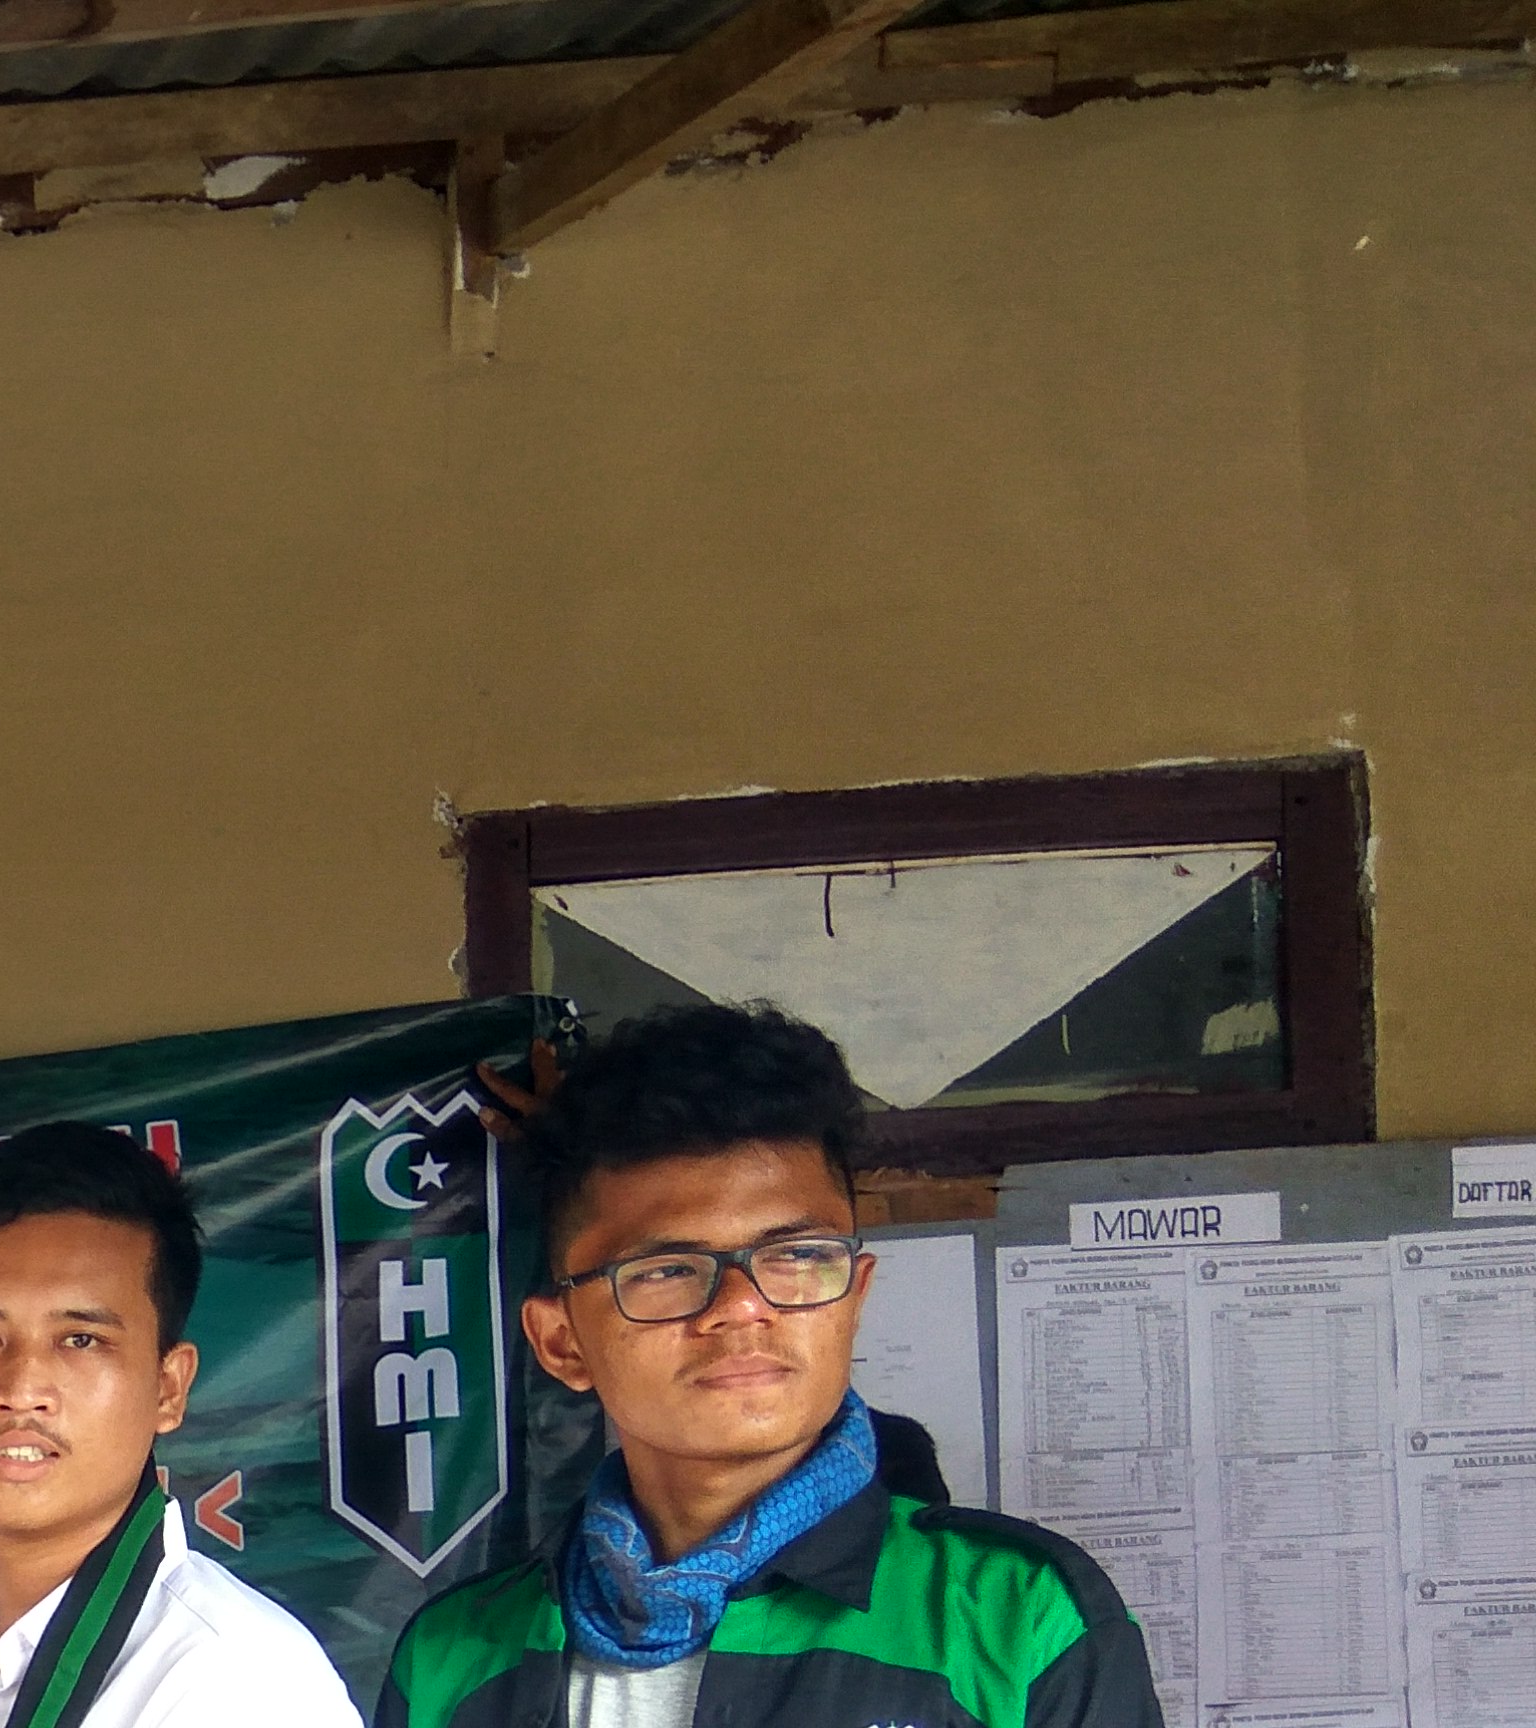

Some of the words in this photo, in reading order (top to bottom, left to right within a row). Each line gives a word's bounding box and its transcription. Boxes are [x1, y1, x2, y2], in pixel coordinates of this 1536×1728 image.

[1458, 1180, 1532, 1204] DAFTAR
[1093, 1206, 1223, 1243] MAWAR
[373, 1258, 461, 1513] HMI
